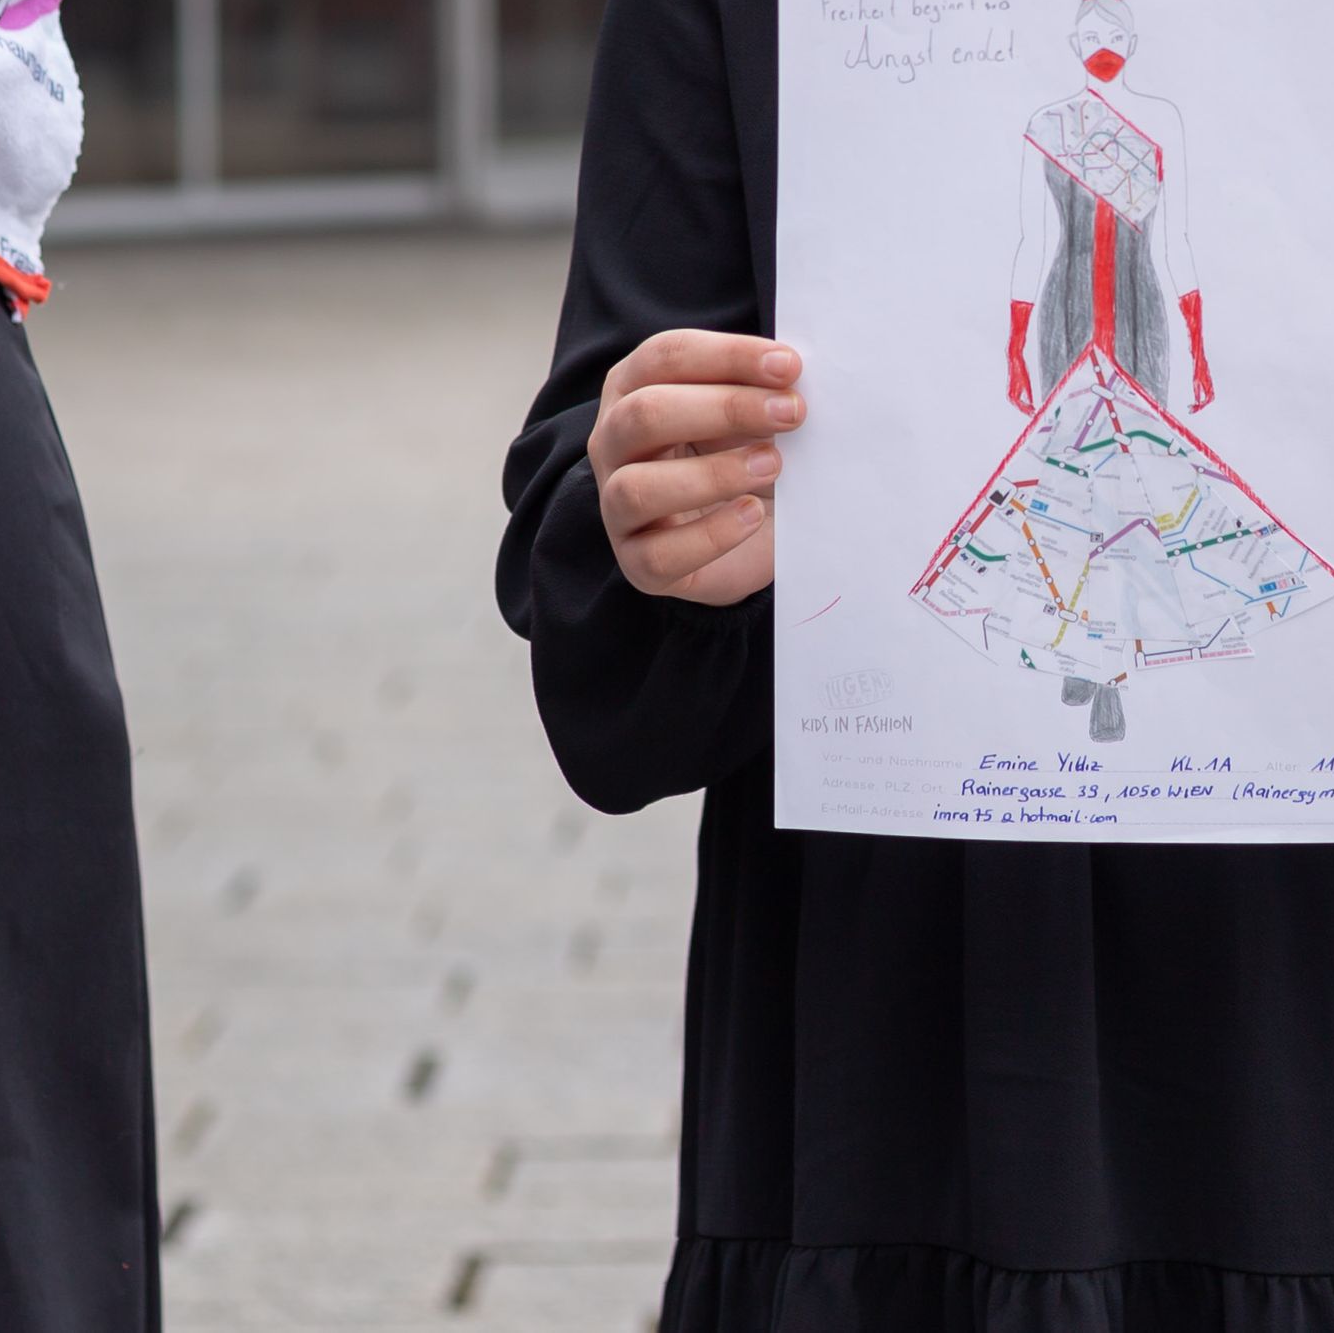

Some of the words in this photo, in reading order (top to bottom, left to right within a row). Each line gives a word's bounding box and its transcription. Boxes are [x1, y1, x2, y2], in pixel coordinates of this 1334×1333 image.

[844, 24, 934, 84] Angst
[801, 715, 829, 734] KIDS
[835, 715, 849, 734] IN
[856, 715, 913, 734] FASHION
[979, 753, 1038, 771] Emine
[961, 778, 1066, 802] Rainergasse
[1116, 784, 1161, 799] 1050
[1168, 785, 1214, 799] WIEN
